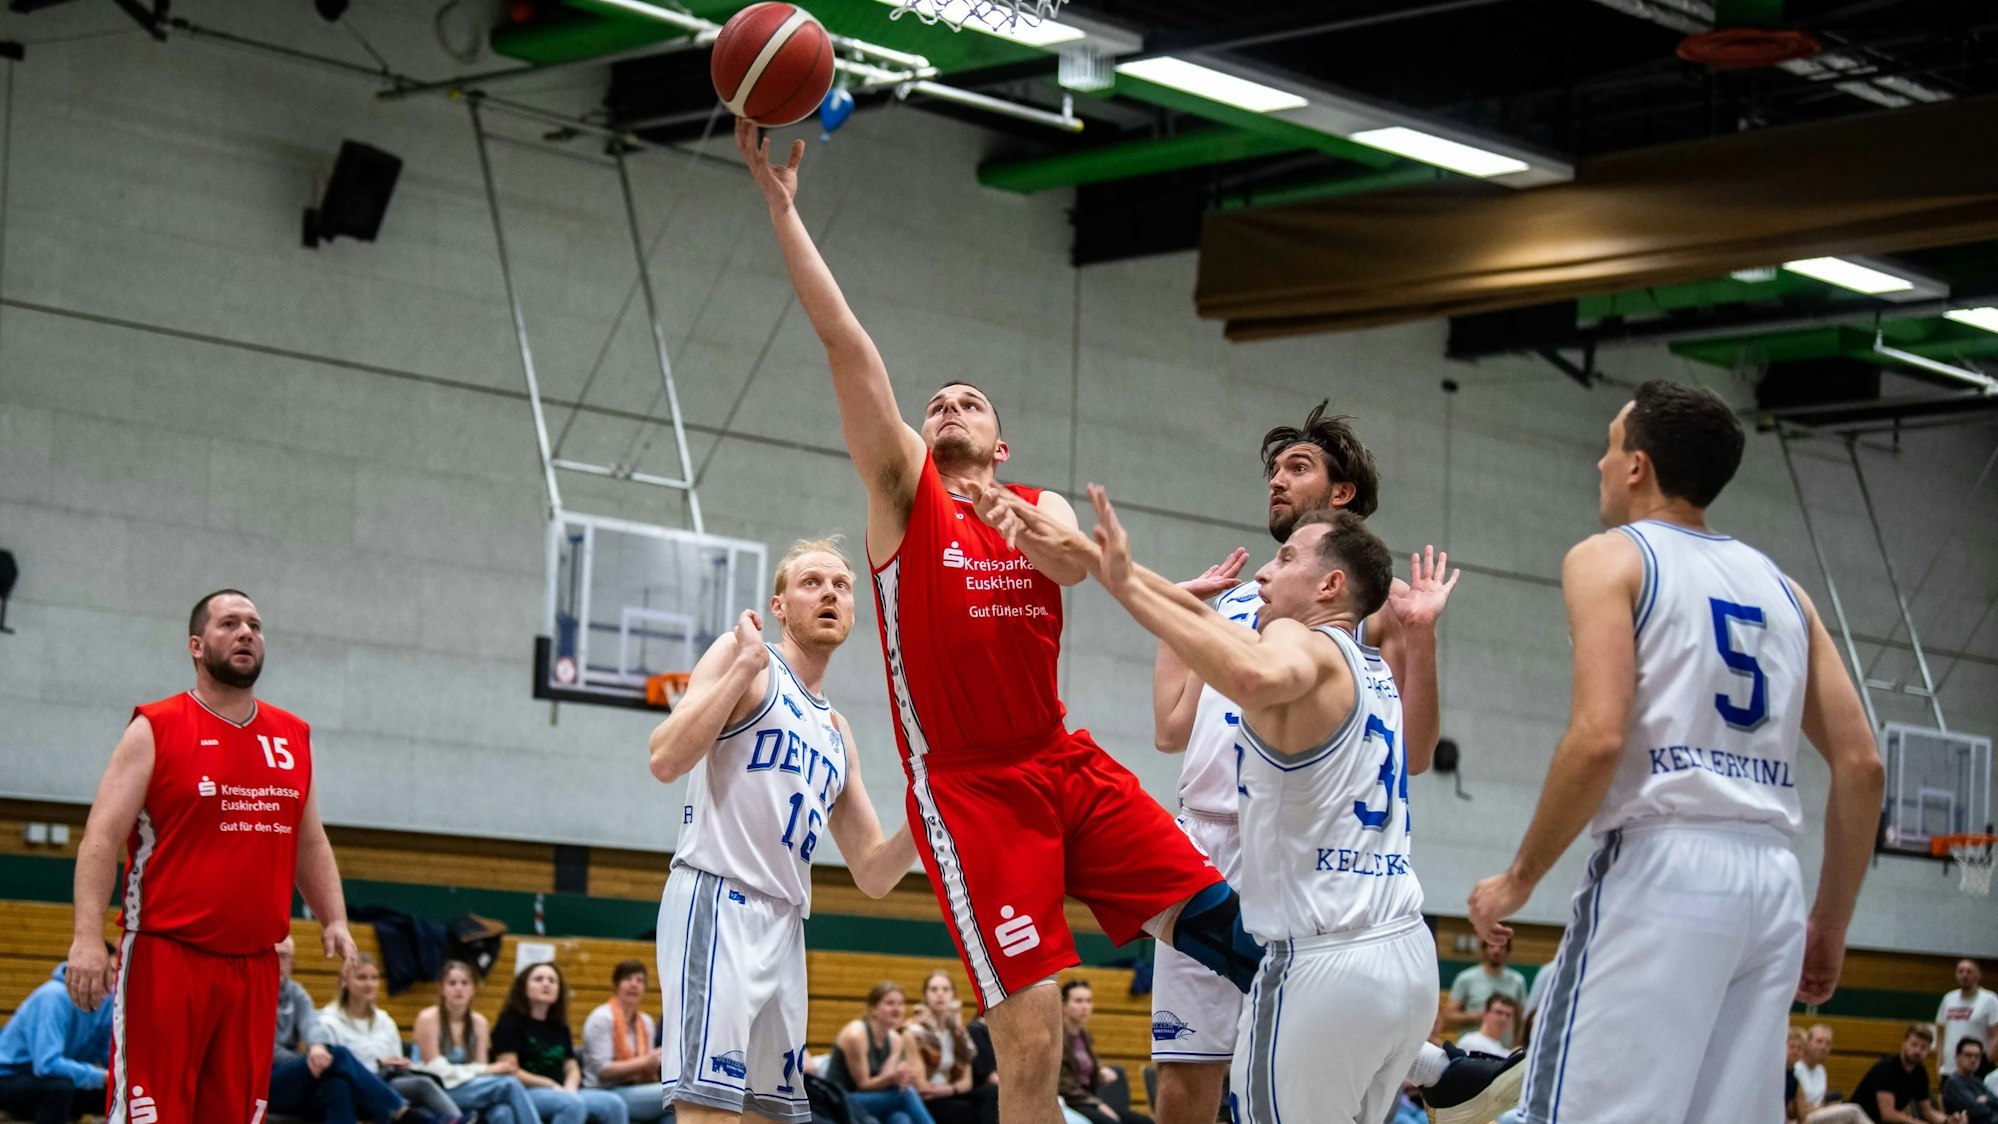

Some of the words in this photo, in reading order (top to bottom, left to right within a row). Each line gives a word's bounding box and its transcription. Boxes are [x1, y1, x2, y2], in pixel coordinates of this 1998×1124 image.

[969, 605, 990, 618] Gut
[1708, 597, 1770, 734] 5
[256, 734, 295, 770] 15
[747, 728, 842, 802] DEUT
[221, 784, 300, 799] Kreissparkasse
[221, 800, 280, 811] Euskirchen
[220, 822, 238, 832] Gut
[239, 822, 253, 832] für
[255, 822, 272, 833] den
[781, 792, 821, 862] 16
